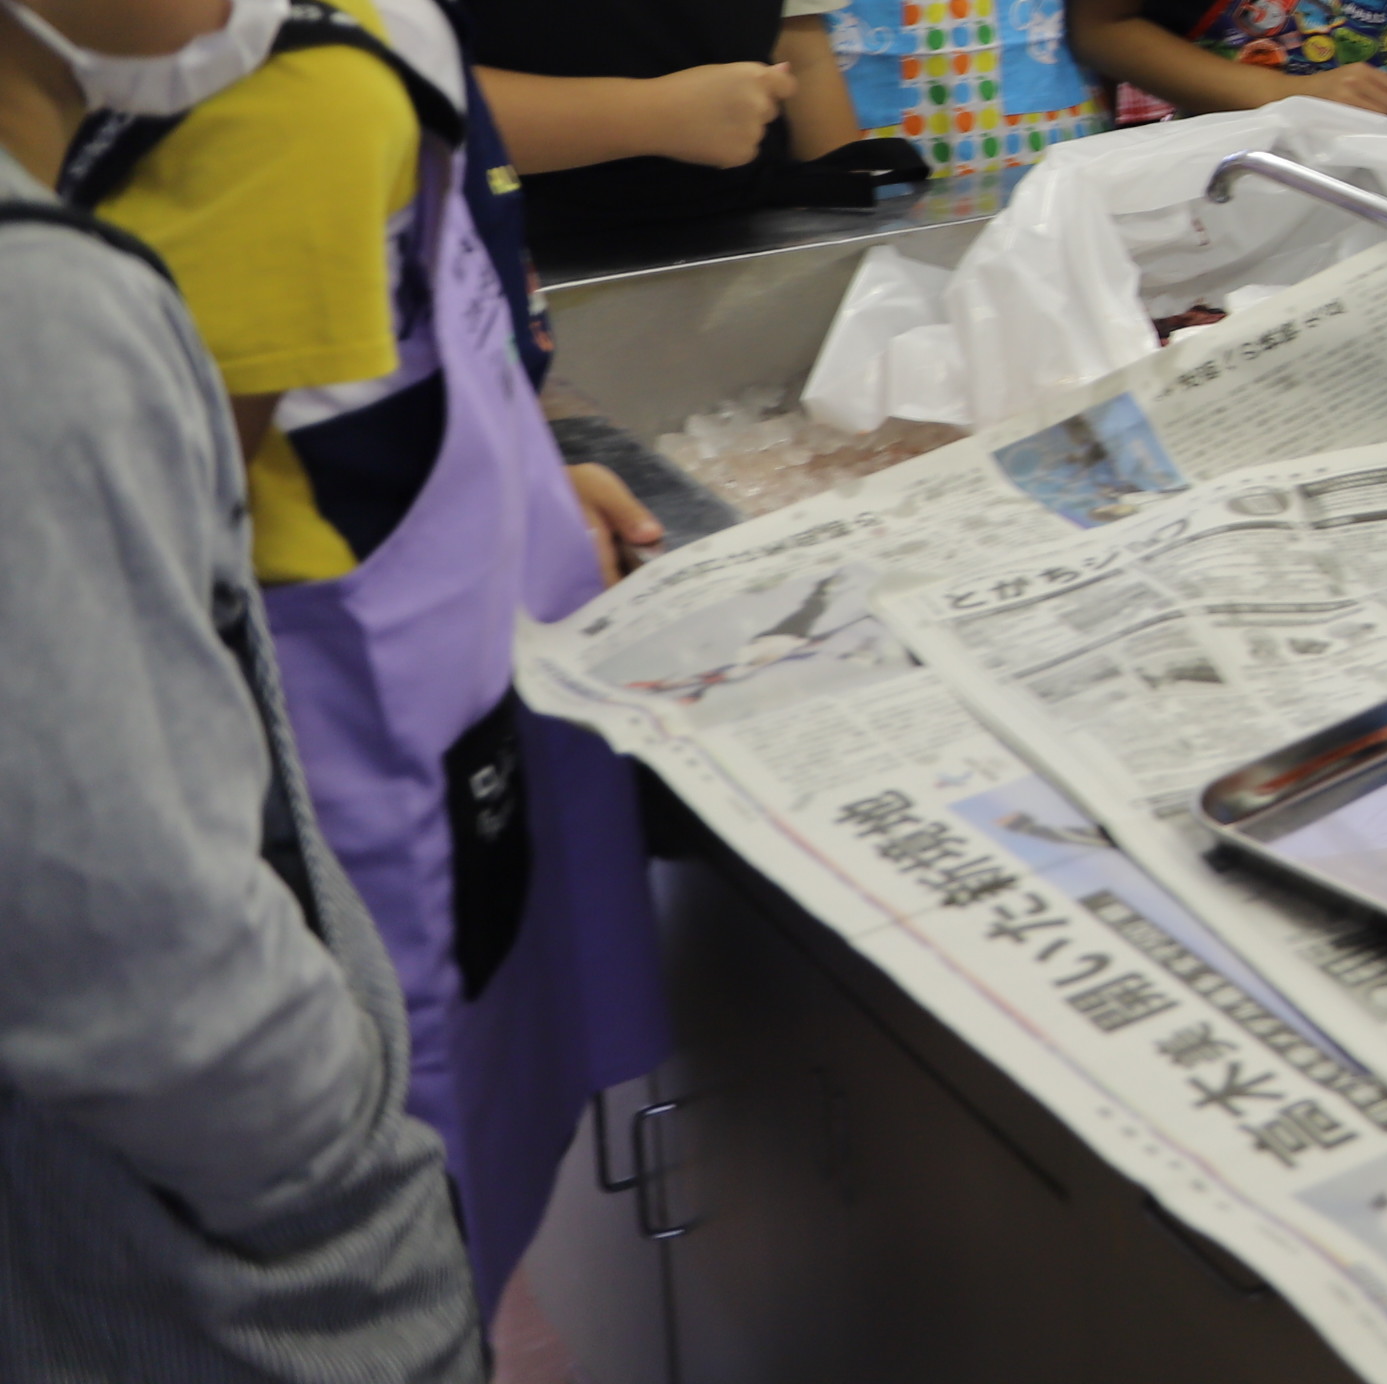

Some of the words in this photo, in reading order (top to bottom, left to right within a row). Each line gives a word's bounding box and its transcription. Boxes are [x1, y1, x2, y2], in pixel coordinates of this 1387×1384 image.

[833, 786, 1184, 1038] 開いた新境地
[1154, 1033, 1362, 1172] 高木美
